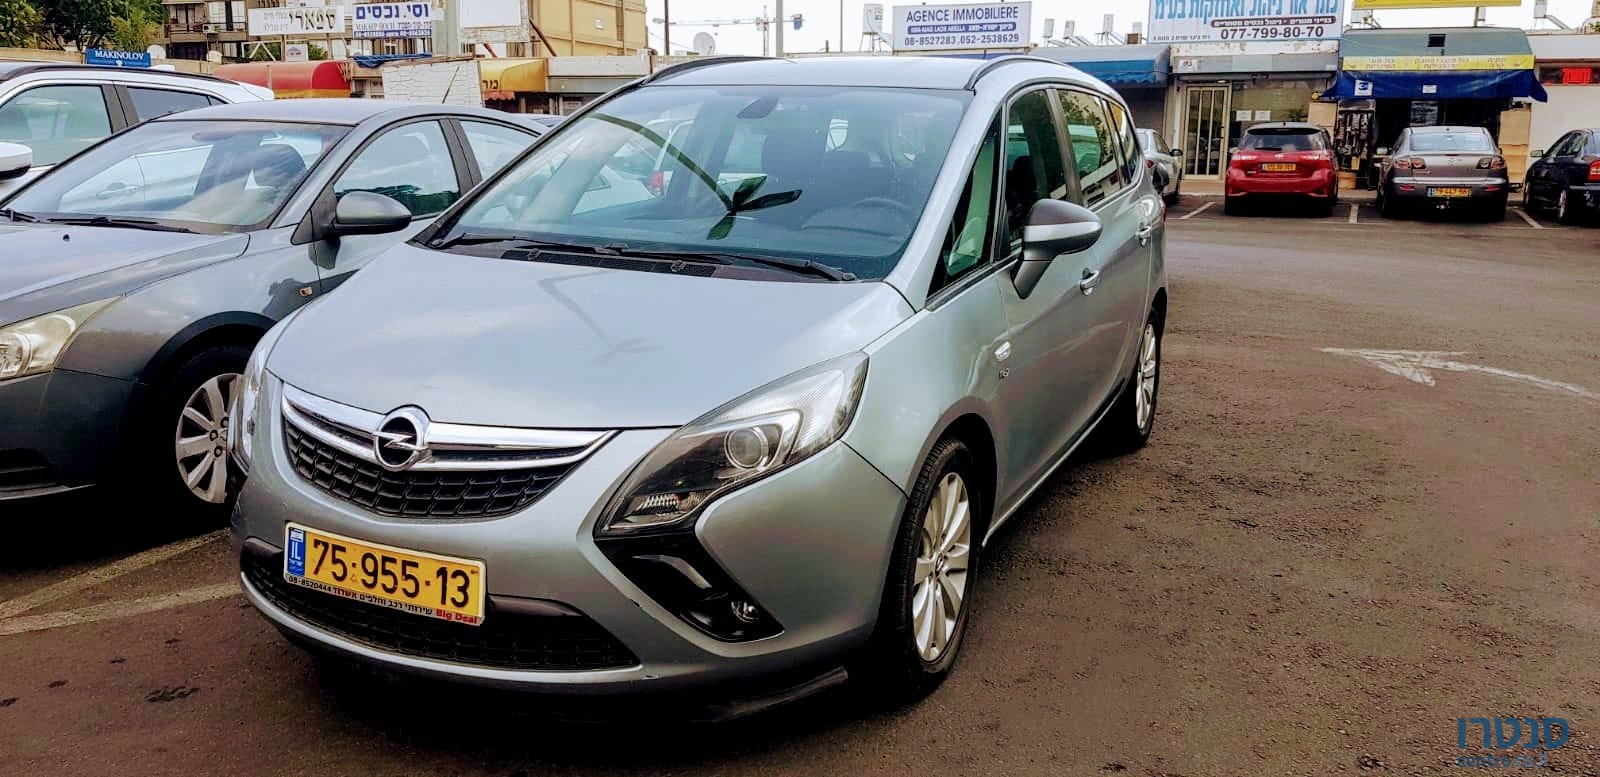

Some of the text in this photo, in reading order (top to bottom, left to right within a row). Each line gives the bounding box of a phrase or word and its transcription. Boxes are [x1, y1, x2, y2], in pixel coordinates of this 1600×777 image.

[289, 8, 337, 30] ספארי
[356, 5, 400, 20] נכסים
[906, 6, 1019, 22] AGENCE IMMOBILIERE
[1221, 26, 1324, 40] 077-799-80-70
[904, 35, 956, 46] 08-8527283
[291, 541, 301, 561] IL
[288, 575, 332, 592] 08-8520444
[388, 600, 403, 609] רכב
[404, 604, 433, 615] שירותי
[435, 608, 453, 621] Big
[455, 612, 478, 624] Deal
